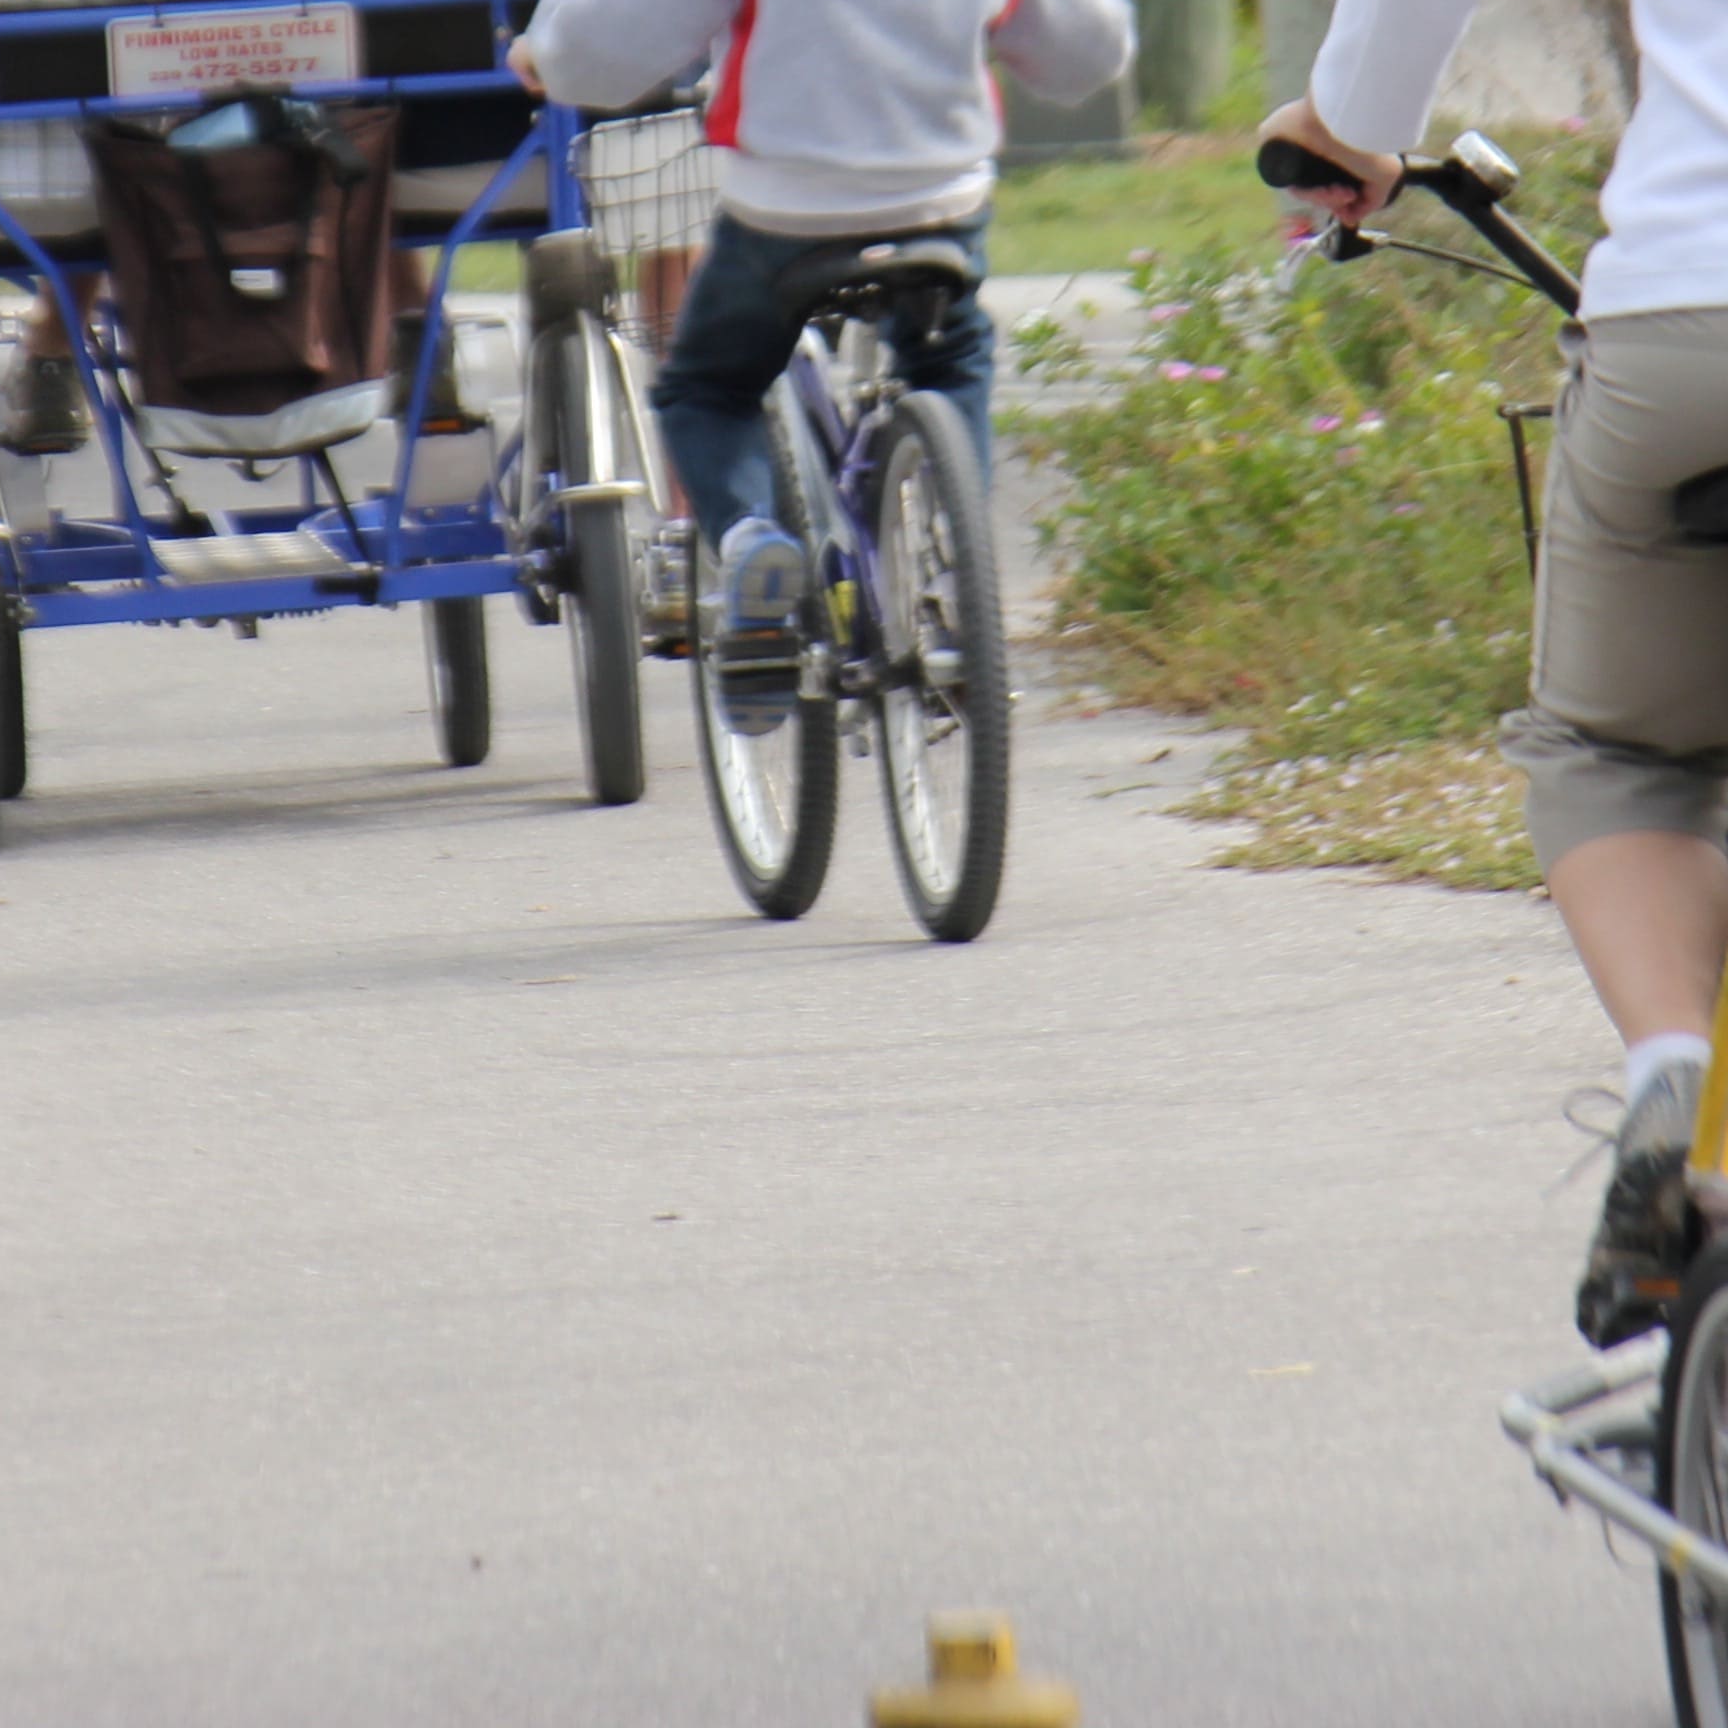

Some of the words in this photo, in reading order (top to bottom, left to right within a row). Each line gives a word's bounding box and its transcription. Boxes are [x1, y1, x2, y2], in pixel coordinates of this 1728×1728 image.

[270, 18, 336, 38] CYCLE
[179, 45, 218, 61] LOW
[227, 41, 283, 57] RATES
[186, 57, 319, 80] 472-5577
